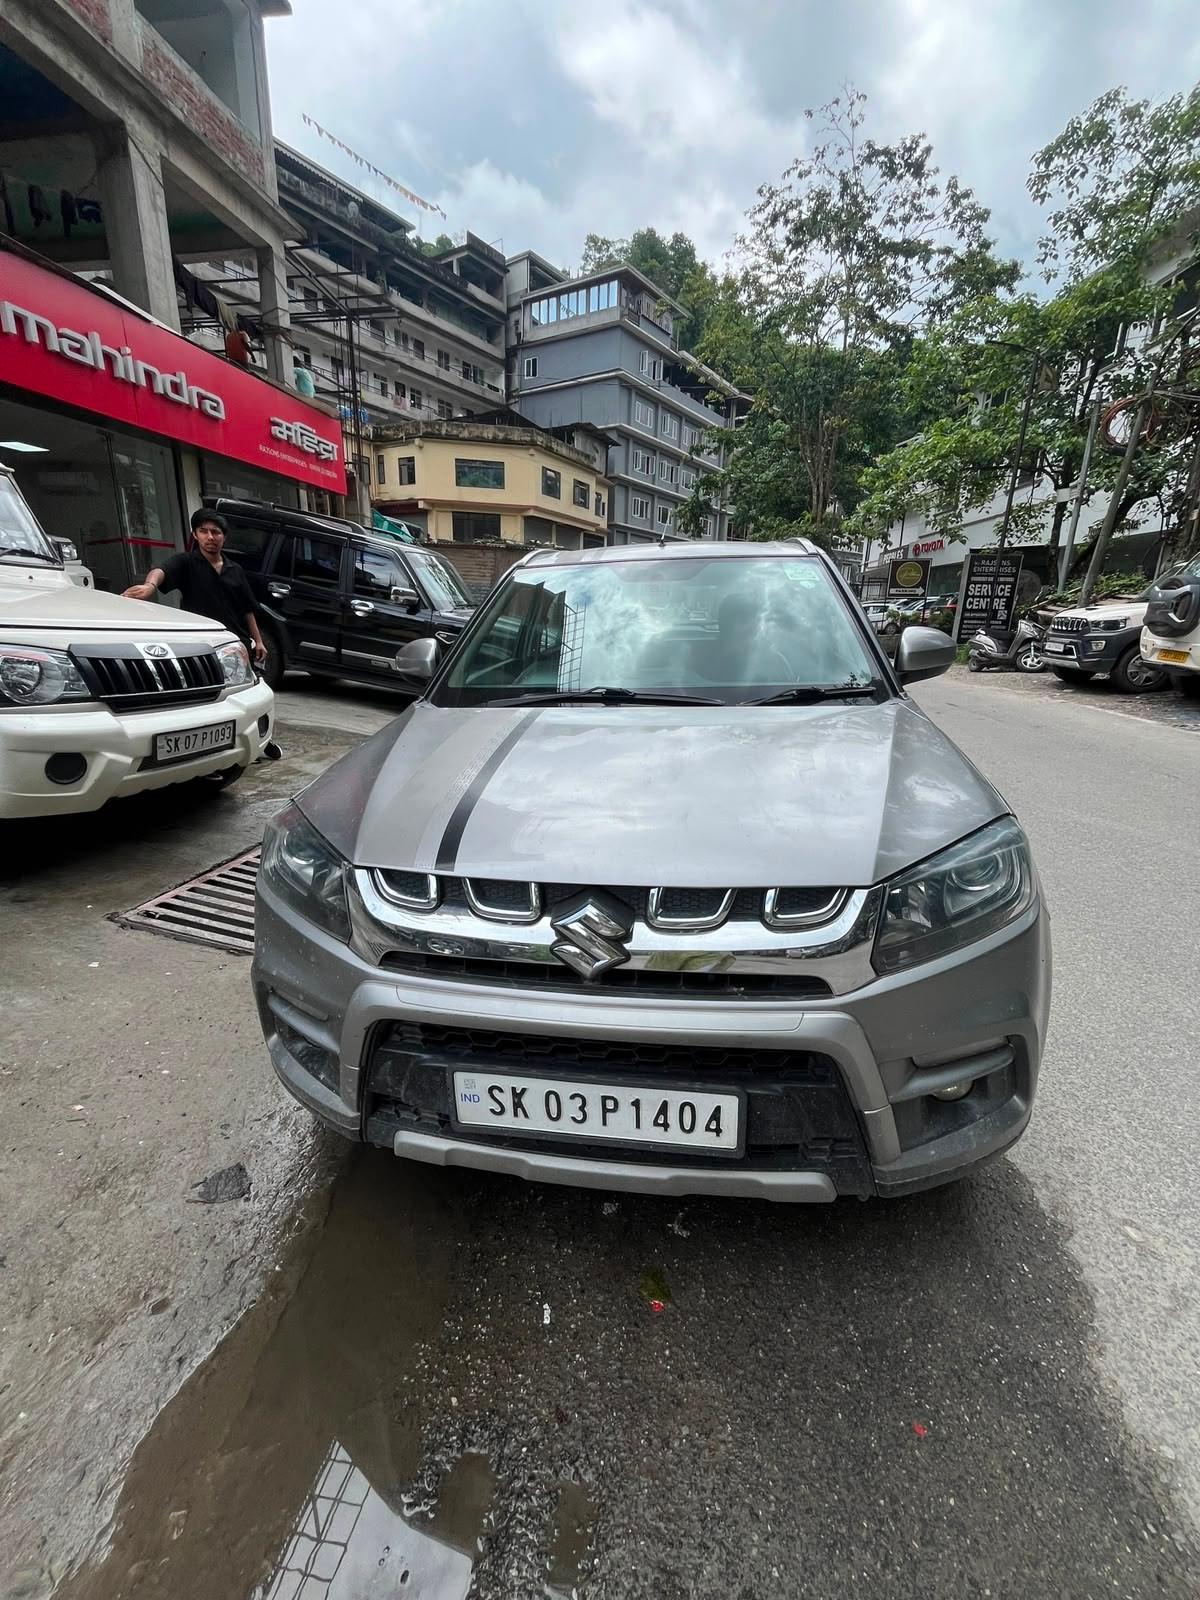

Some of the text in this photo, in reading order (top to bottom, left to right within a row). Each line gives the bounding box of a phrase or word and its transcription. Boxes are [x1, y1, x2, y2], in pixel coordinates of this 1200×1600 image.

[1, 301, 226, 420] mahindra
[921, 539, 945, 553] TOYOTA
[166, 736, 181, 753] SK
[184, 733, 198, 750] 07
[460, 1093, 480, 1104] IND
[487, 1084, 530, 1120] SK
[544, 1089, 587, 1124] 03
